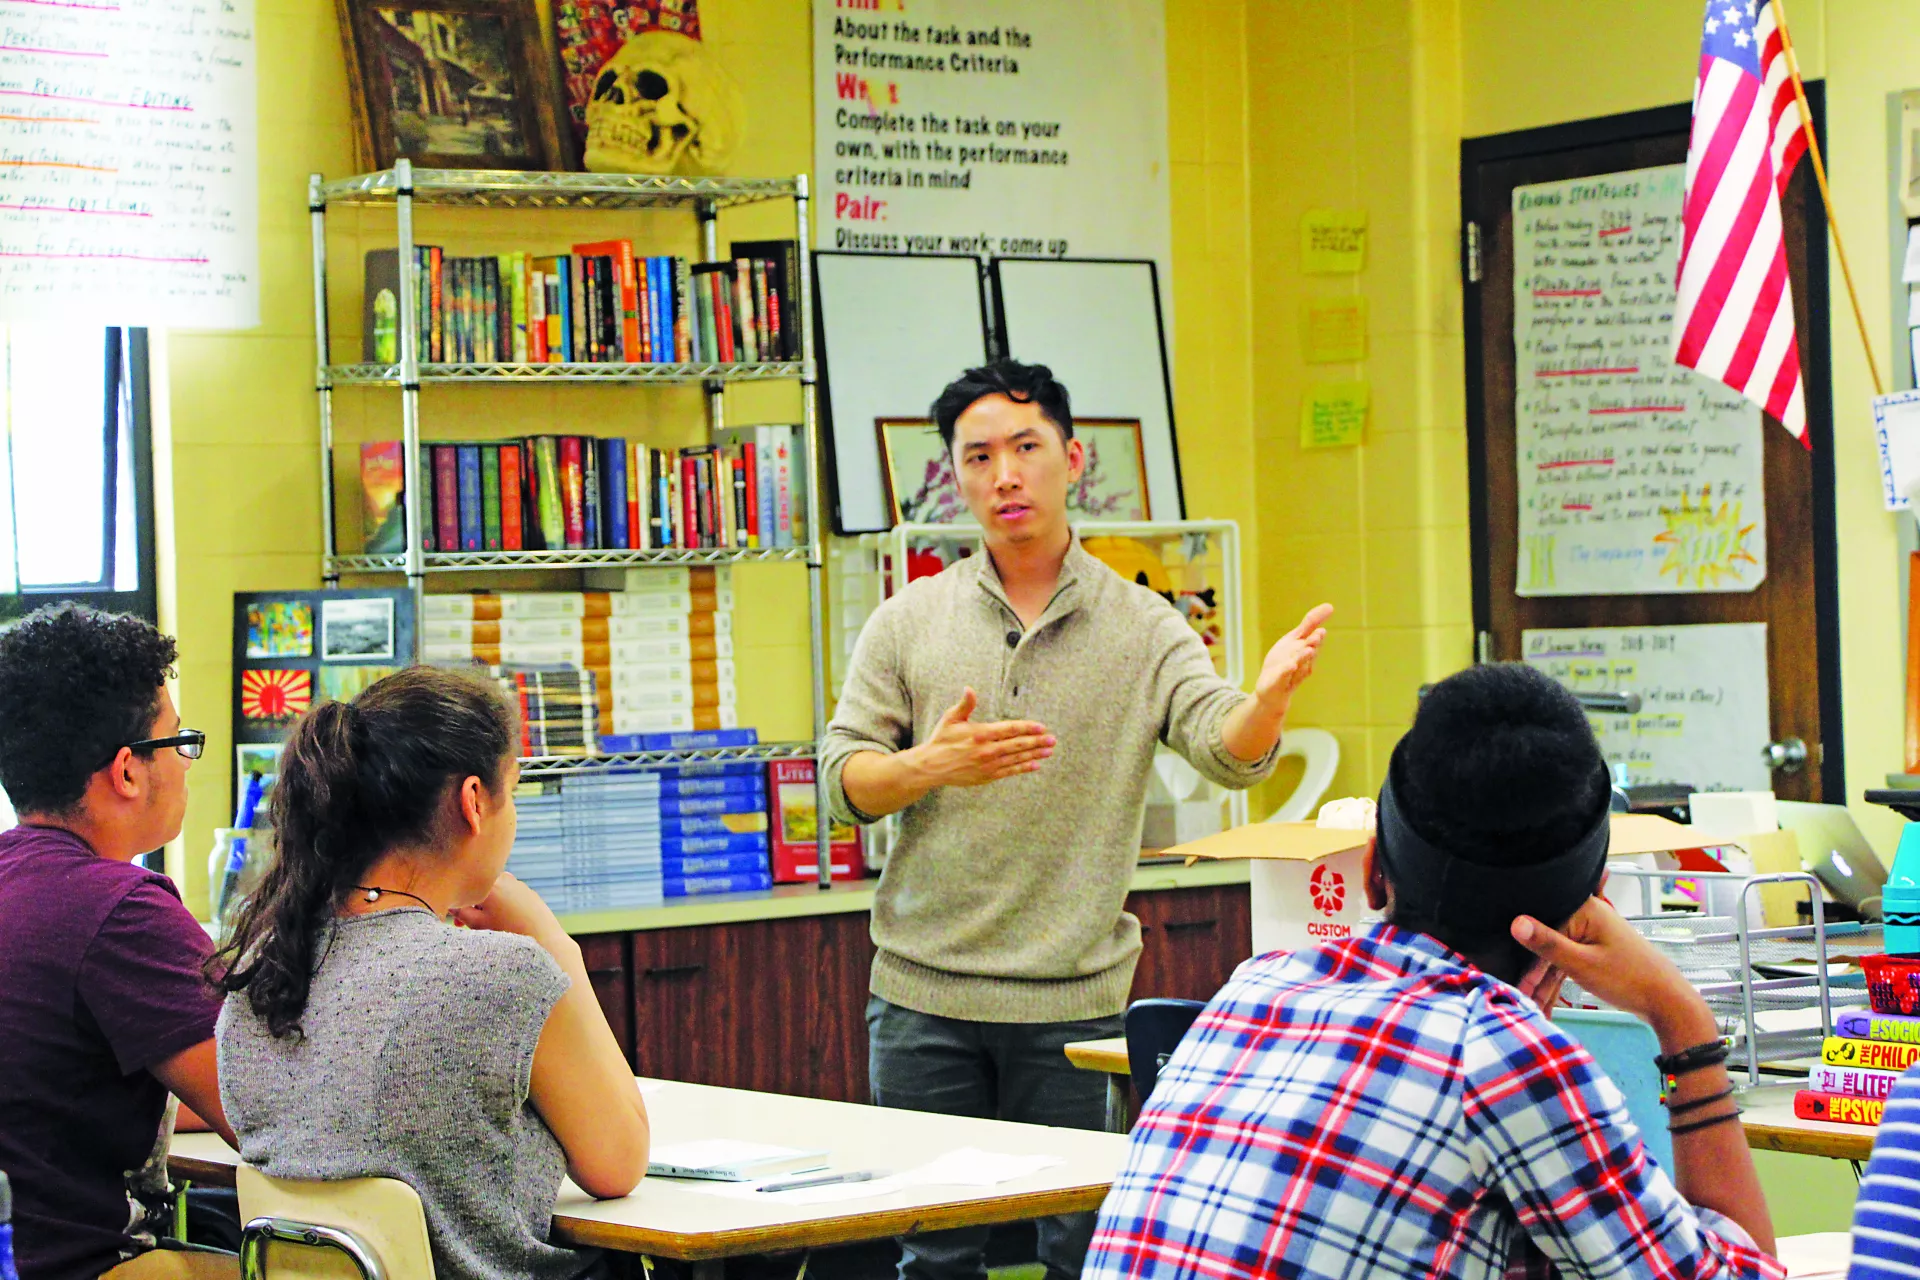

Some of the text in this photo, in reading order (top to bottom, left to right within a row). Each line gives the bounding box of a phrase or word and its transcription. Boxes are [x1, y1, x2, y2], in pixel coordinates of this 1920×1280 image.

[834, 17, 1031, 49] About the task and the
[834, 44, 1019, 75] Performance Criteria
[836, 107, 1061, 140] Complete the task on your
[835, 139, 1068, 166] own, with the performance
[835, 168, 971, 190] criteria in mind
[835, 192, 887, 222] Pair:
[836, 227, 898, 249] Discuss
[904, 233, 943, 254] your
[1000, 234, 1042, 254] come
[1048, 237, 1069, 256] up
[1307, 922, 1350, 937] CUSTOM
[1859, 1044, 1920, 1069] THE PHILO
[1843, 1072, 1853, 1092] THE
[1830, 1097, 1887, 1124] THE PSYC
